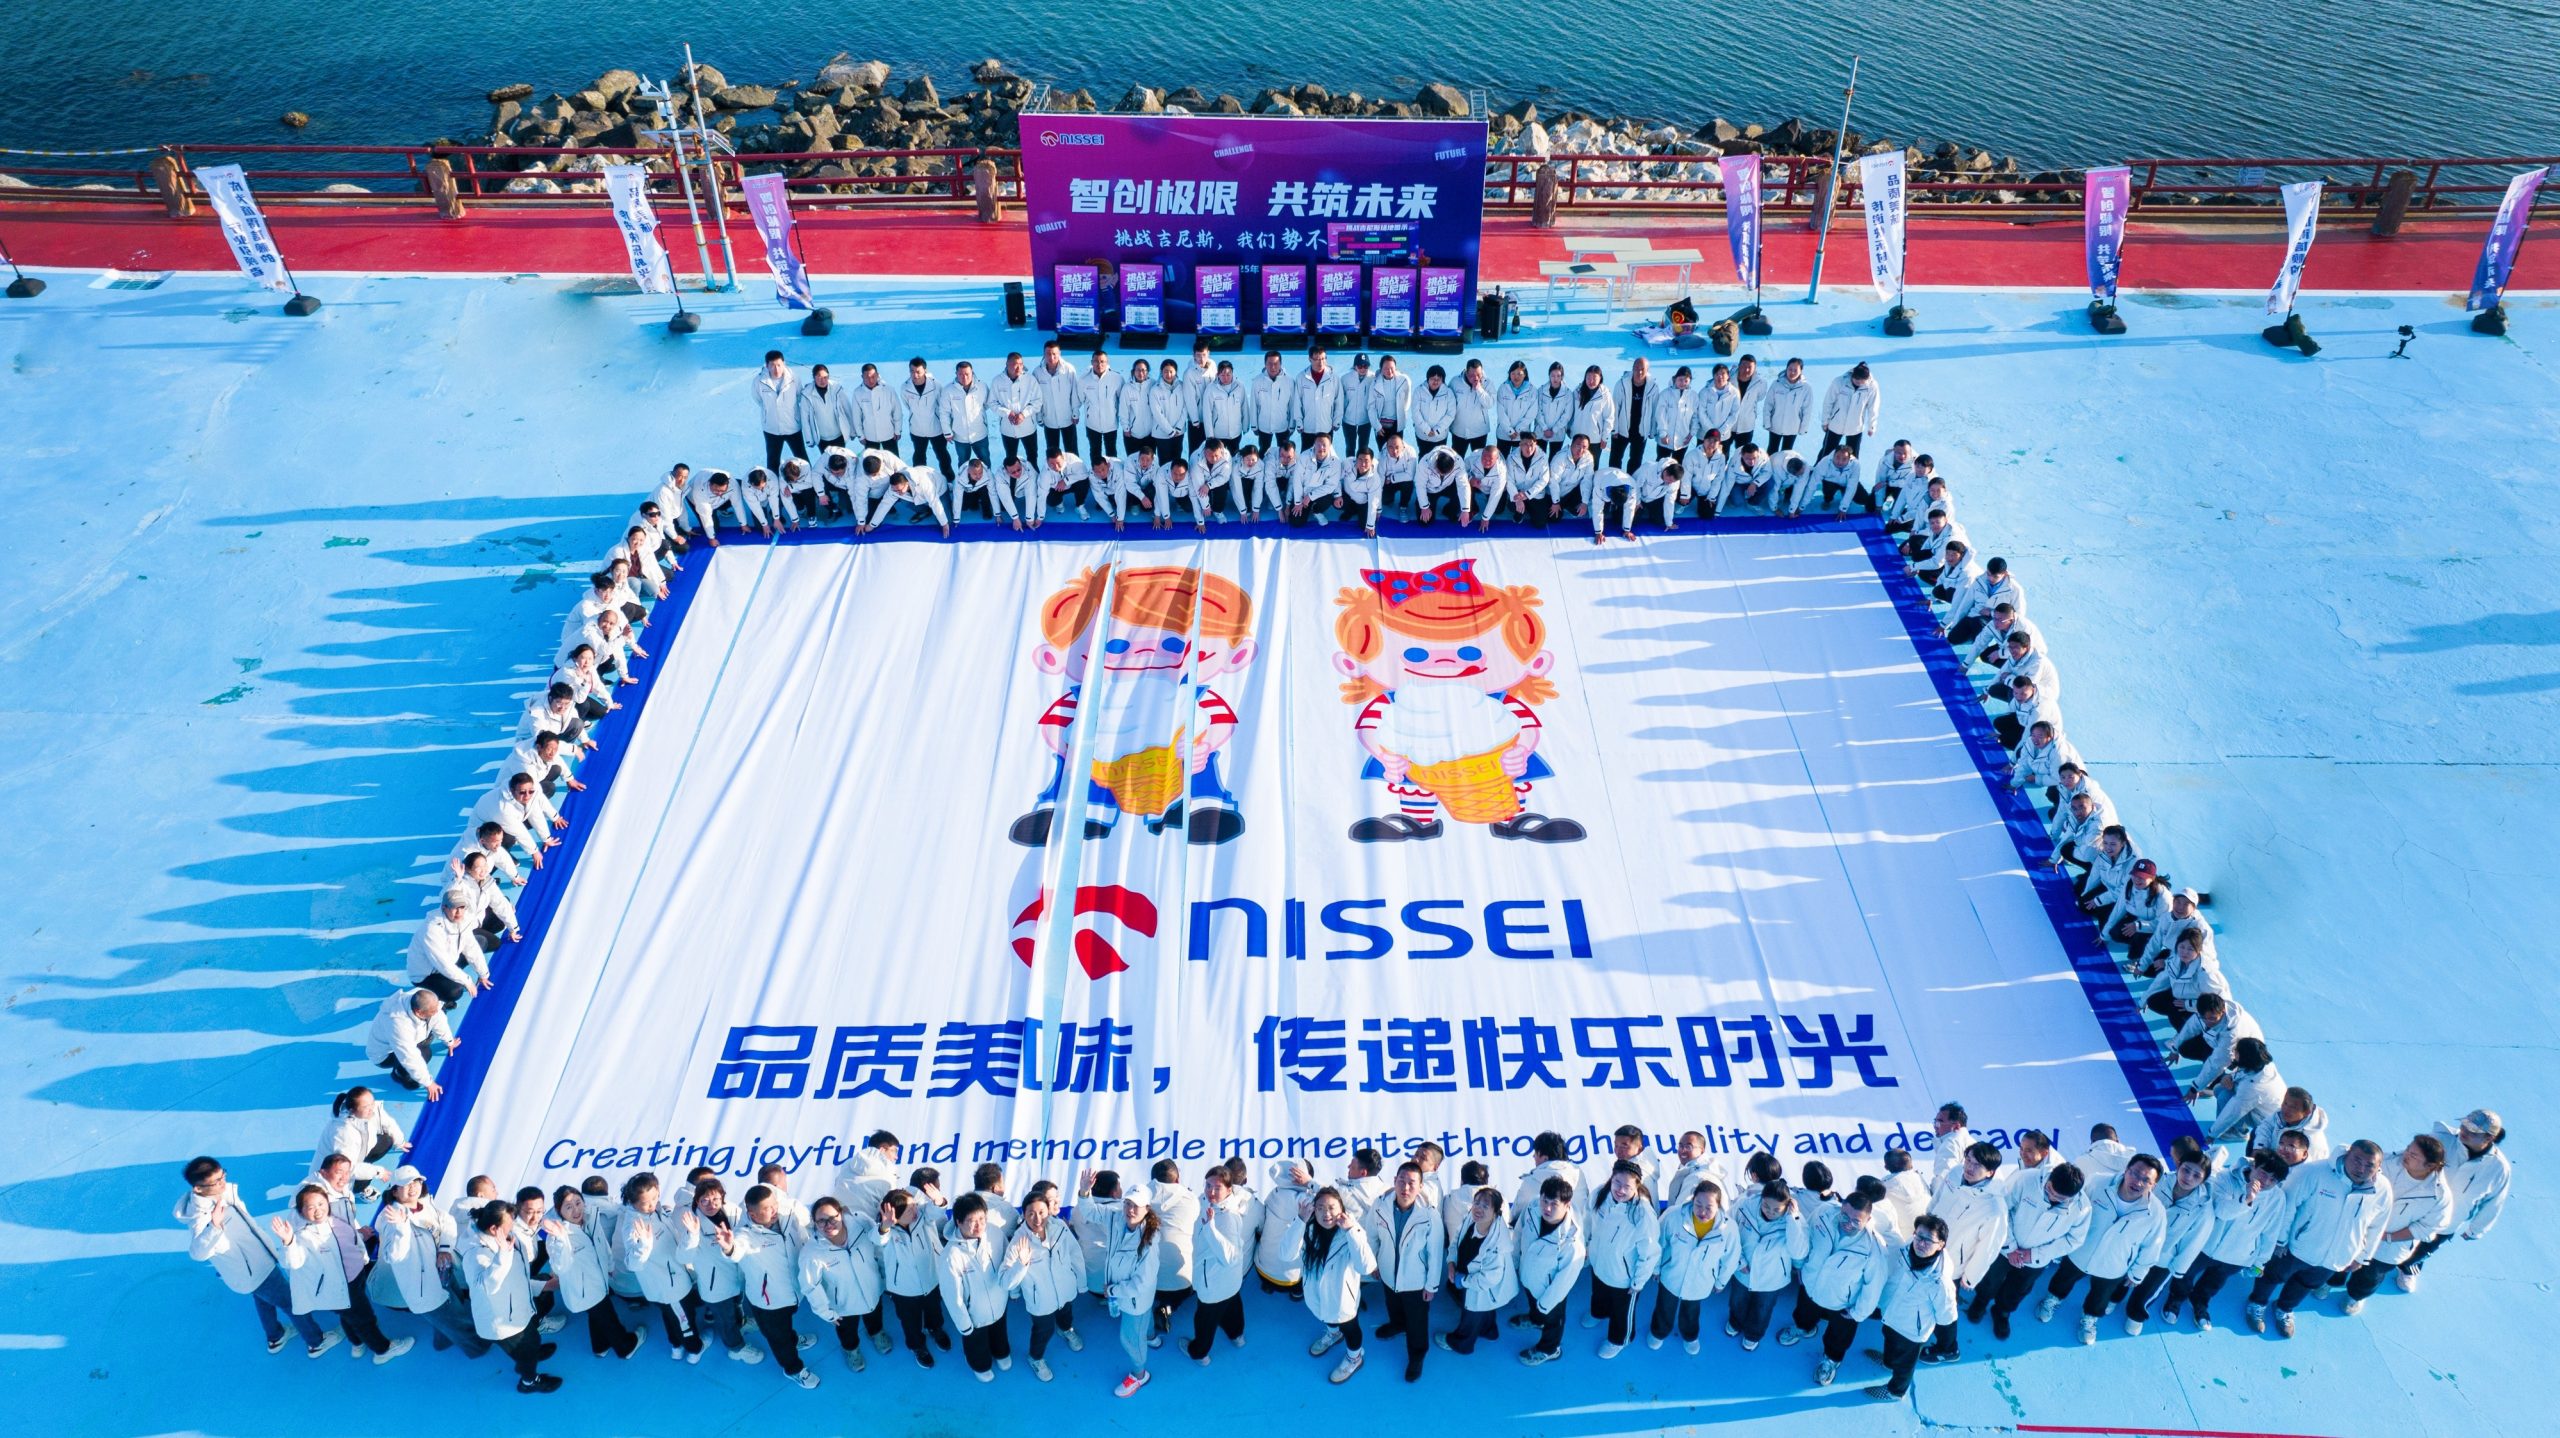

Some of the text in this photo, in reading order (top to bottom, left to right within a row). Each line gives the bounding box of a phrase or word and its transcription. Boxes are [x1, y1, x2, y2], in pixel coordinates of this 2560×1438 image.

[1060, 133, 1104, 145] NISSEI
[1213, 144, 1254, 158] CHALLENGE
[1434, 148, 1467, 161] FUTURE
[1069, 178, 1438, 219] 智创极限 共筑未来
[1034, 220, 1067, 234] QUALITY
[1187, 897, 1594, 961] NISSEI
[543, 1136, 739, 1175] Creating
[972, 1127, 1205, 1163] memorable
[1437, 1124, 1614, 1164] throgh
[1793, 1123, 1873, 1156] and
